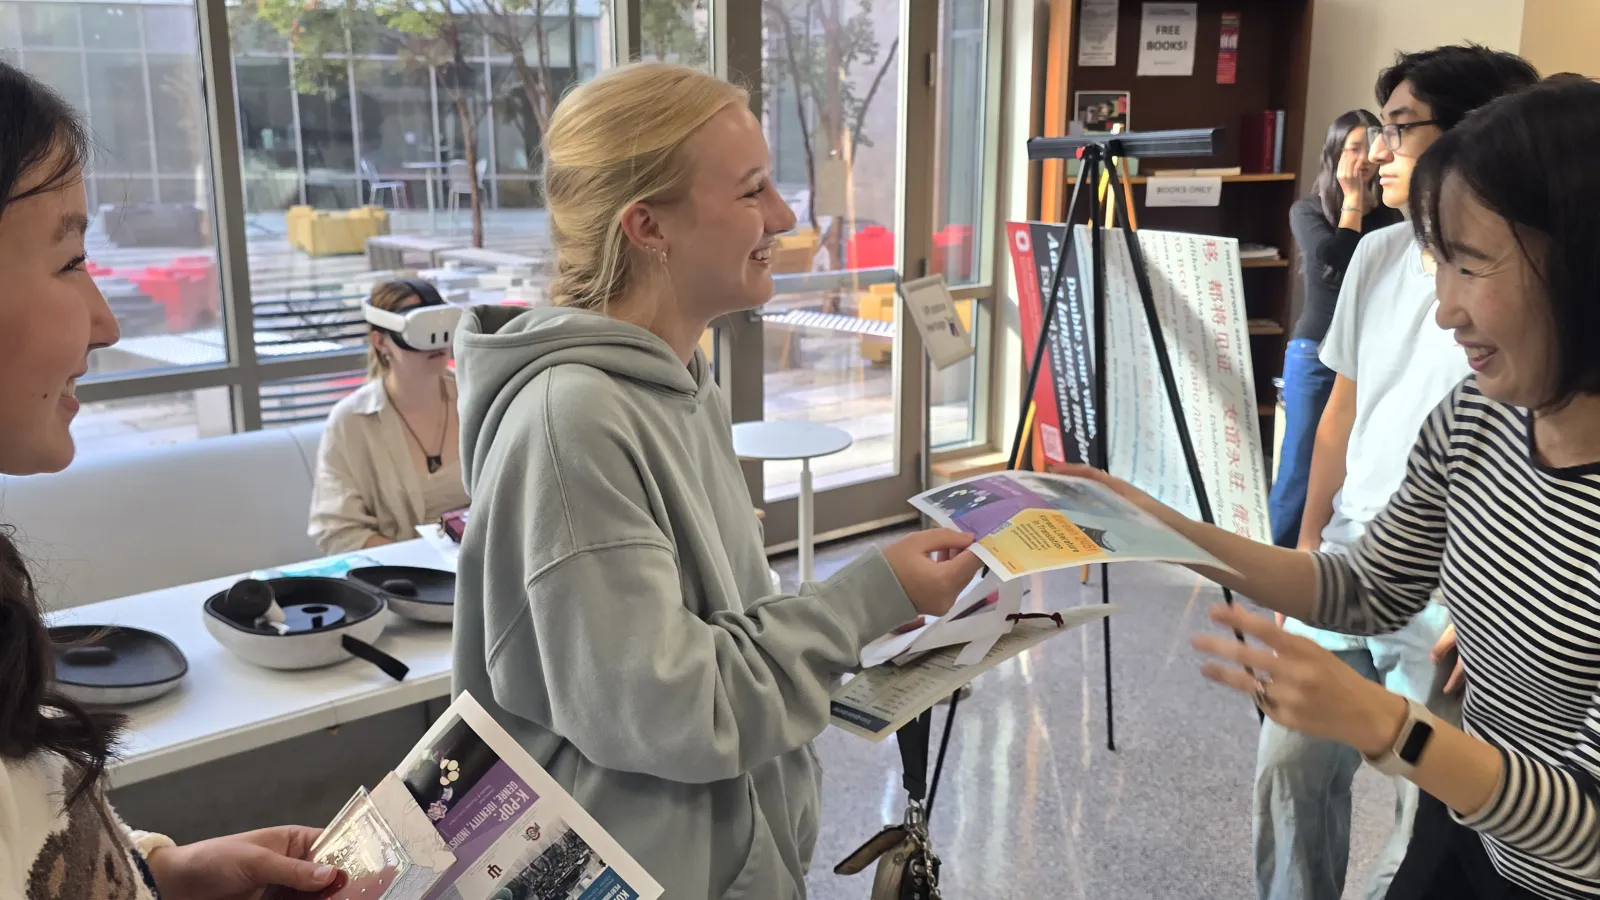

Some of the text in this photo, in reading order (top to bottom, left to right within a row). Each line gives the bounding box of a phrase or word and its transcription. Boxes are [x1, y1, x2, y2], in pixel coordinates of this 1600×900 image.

[1155, 25, 1180, 35] FREE
[1146, 40, 1188, 51] BOOKS!
[1156, 185, 1213, 195] BOOKS ONLY
[1041, 265, 1072, 433] Expd your future.
[1057, 301, 1080, 402] language
[1066, 277, 1097, 439] Double your value.
[1238, 359, 1249, 396] aucun
[1242, 399, 1251, 431] doute
[1248, 442, 1260, 491] Combien
[1056, 530, 1080, 553] Literature
[493, 780, 518, 801] GENRE,
[493, 788, 529, 823] K-POP:
[466, 803, 498, 831] IDENTITY,
[613, 889, 630, 900] KO
